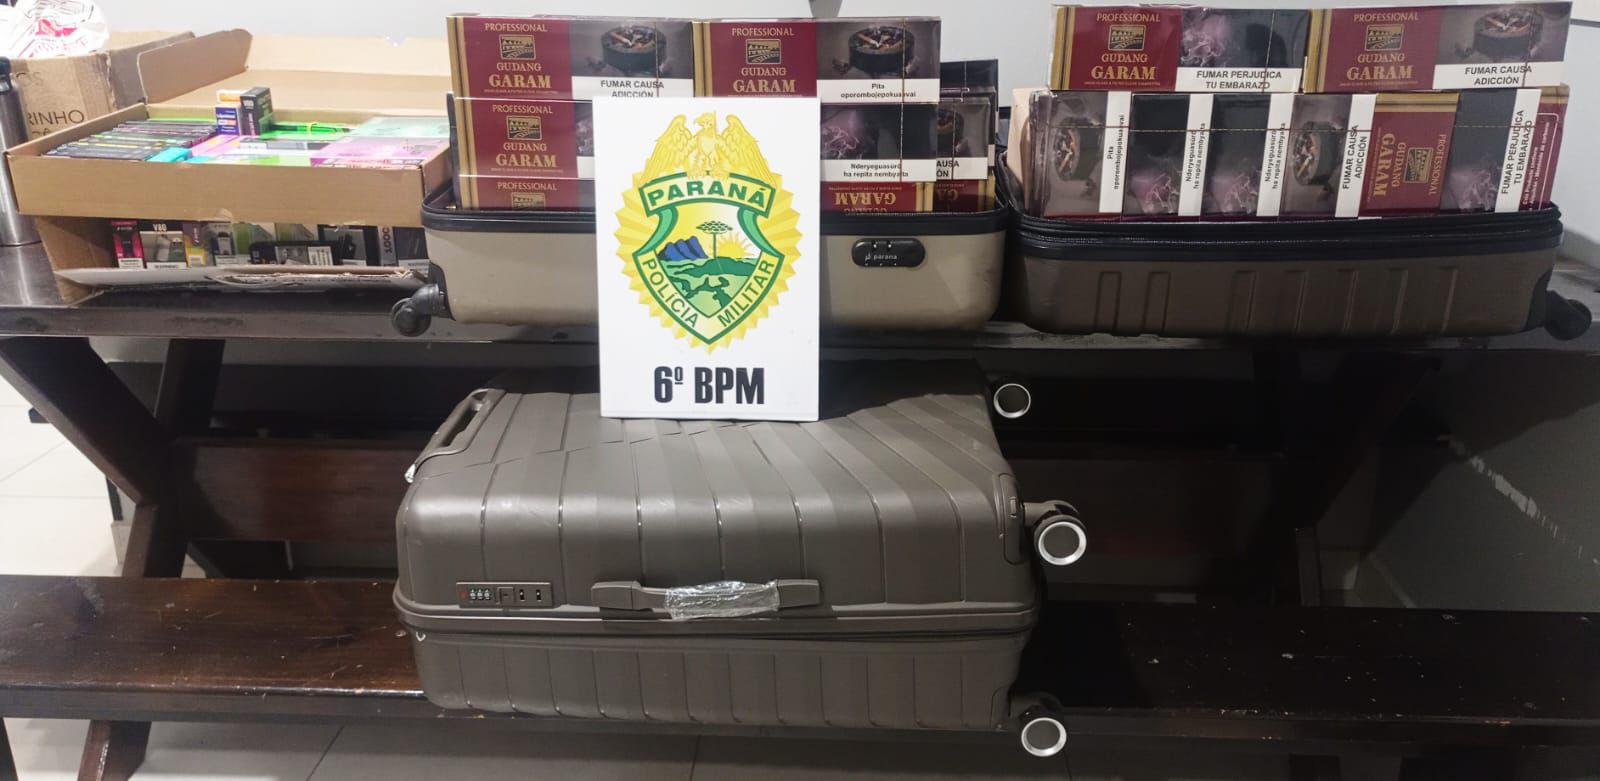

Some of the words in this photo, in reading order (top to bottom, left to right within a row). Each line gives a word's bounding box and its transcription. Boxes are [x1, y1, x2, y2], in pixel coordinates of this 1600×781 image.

[1097, 13, 1161, 23] PROFESSIONAL
[1354, 13, 1419, 22] PROFESSIONAL
[485, 23, 547, 33] PROFESSIONAL
[732, 27, 794, 36] PROFESSIONAL
[1101, 53, 1147, 63] GUDANG
[1357, 53, 1405, 63] GUDANG
[496, 62, 541, 72] GUDANG
[741, 67, 786, 76] GUDANG
[1091, 66, 1156, 80] GARAM
[1346, 65, 1413, 81] GARAM
[1465, 66, 1498, 75] FUMAR
[1499, 65, 1532, 74] CAUSA
[1197, 70, 1229, 78] FUMAR
[1230, 70, 1282, 79] PERJUDICA
[488, 74, 551, 89] GARAM
[600, 79, 631, 88] FUMAR
[633, 80, 665, 89] CAUSA
[733, 79, 796, 93] GARAM
[1205, 81, 1217, 89] TU
[1219, 81, 1271, 89] EMBARAZO
[1474, 76, 1519, 86] ADICCIÓN
[492, 104, 553, 114] PROFESSIONAL
[1347, 124, 1359, 156] CAUSA
[503, 142, 547, 152] GUDANG
[1502, 161, 1514, 194] FUMAR
[1508, 110, 1524, 161] PERJUDICA
[1515, 120, 1533, 173] EMBARAZO
[496, 153, 557, 168] GARAM
[1354, 135, 1367, 179] ADICCIÓN
[1373, 133, 1396, 197] GARAM
[1391, 142, 1407, 188] GUDANG
[1428, 133, 1447, 196] PROFESSIONAL
[1342, 157, 1354, 190] FUMAR
[1514, 174, 1521, 184] TU
[497, 181, 558, 191] PROFESSIONAL
[649, 179, 767, 208] PARANÁ
[835, 192, 897, 206] GARAM
[642, 257, 699, 328] POLÍCIA
[718, 259, 775, 328] MILITAR
[694, 367, 765, 405] BPM
